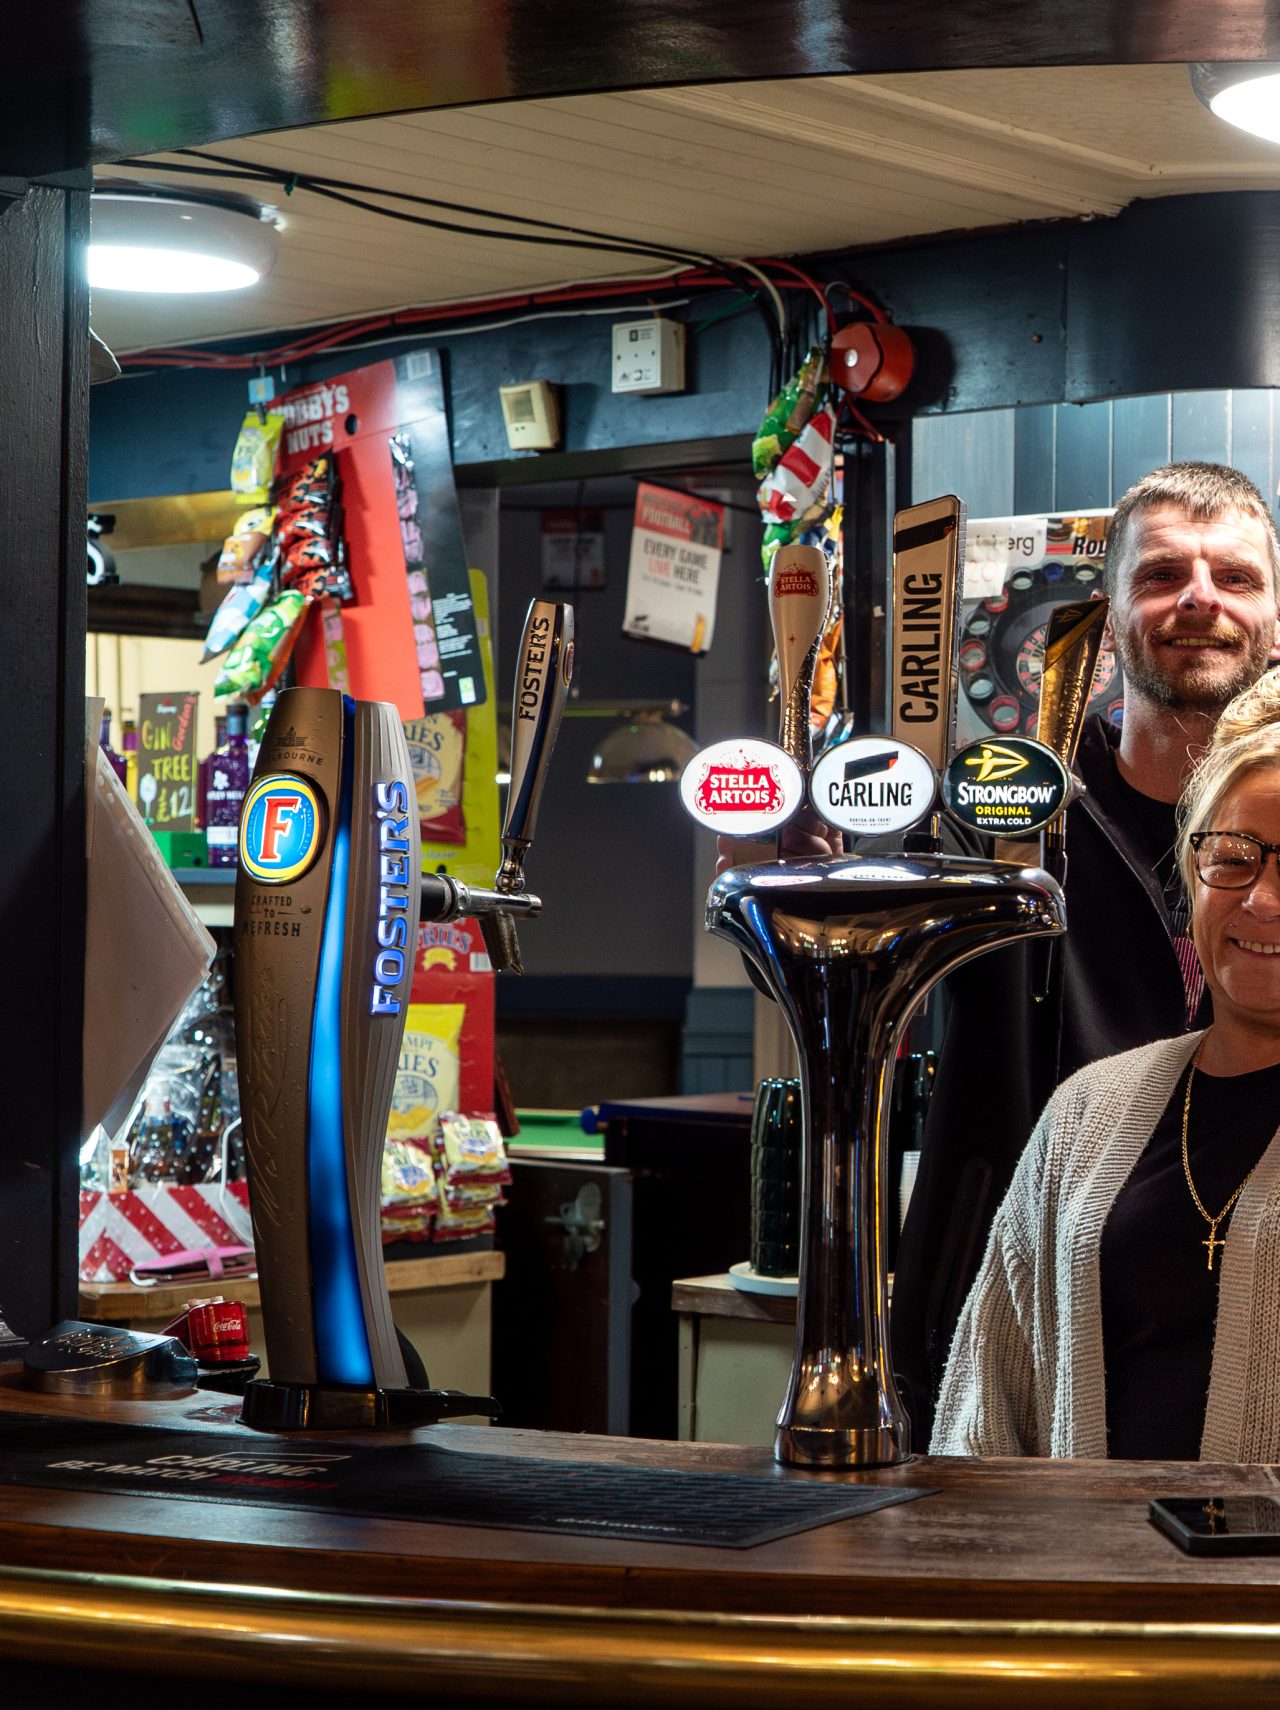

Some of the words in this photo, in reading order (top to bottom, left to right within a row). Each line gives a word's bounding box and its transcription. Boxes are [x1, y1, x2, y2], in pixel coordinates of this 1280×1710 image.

[286, 421, 334, 455] NUTS
[644, 537, 675, 557] EVERY
[678, 547, 708, 570] GAME
[780, 576, 811, 584] STELLA
[780, 583, 812, 591] ARTOIS
[899, 573, 943, 723] CARLING
[518, 617, 551, 722] FOSTER'S
[141, 719, 173, 751] GIN
[402, 724, 445, 751] IES
[152, 754, 192, 782] TREE
[709, 774, 770, 789] STELLA
[957, 782, 1054, 805] STRONGBOW
[156, 785, 193, 823] £12
[709, 789, 771, 804] ARTOIS
[828, 781, 913, 807] CARLING
[975, 805, 1032, 816] ORIGINAL
[976, 817, 1005, 825] EXTRA
[1006, 817, 1032, 825] COLD
[257, 796, 302, 863] F
[251, 895, 293, 906] CRAFTED
[369, 780, 411, 1015] FOSTER'S
[263, 908, 276, 918] TO
[242, 922, 302, 937] REFRESH
[417, 926, 472, 955] RIES
[406, 1035, 433, 1051] MPI
[397, 1052, 440, 1078] IES
[45, 1459, 107, 1472] BE
[93, 1463, 219, 1481] MATCH
[145, 1454, 329, 1477] CARLING
